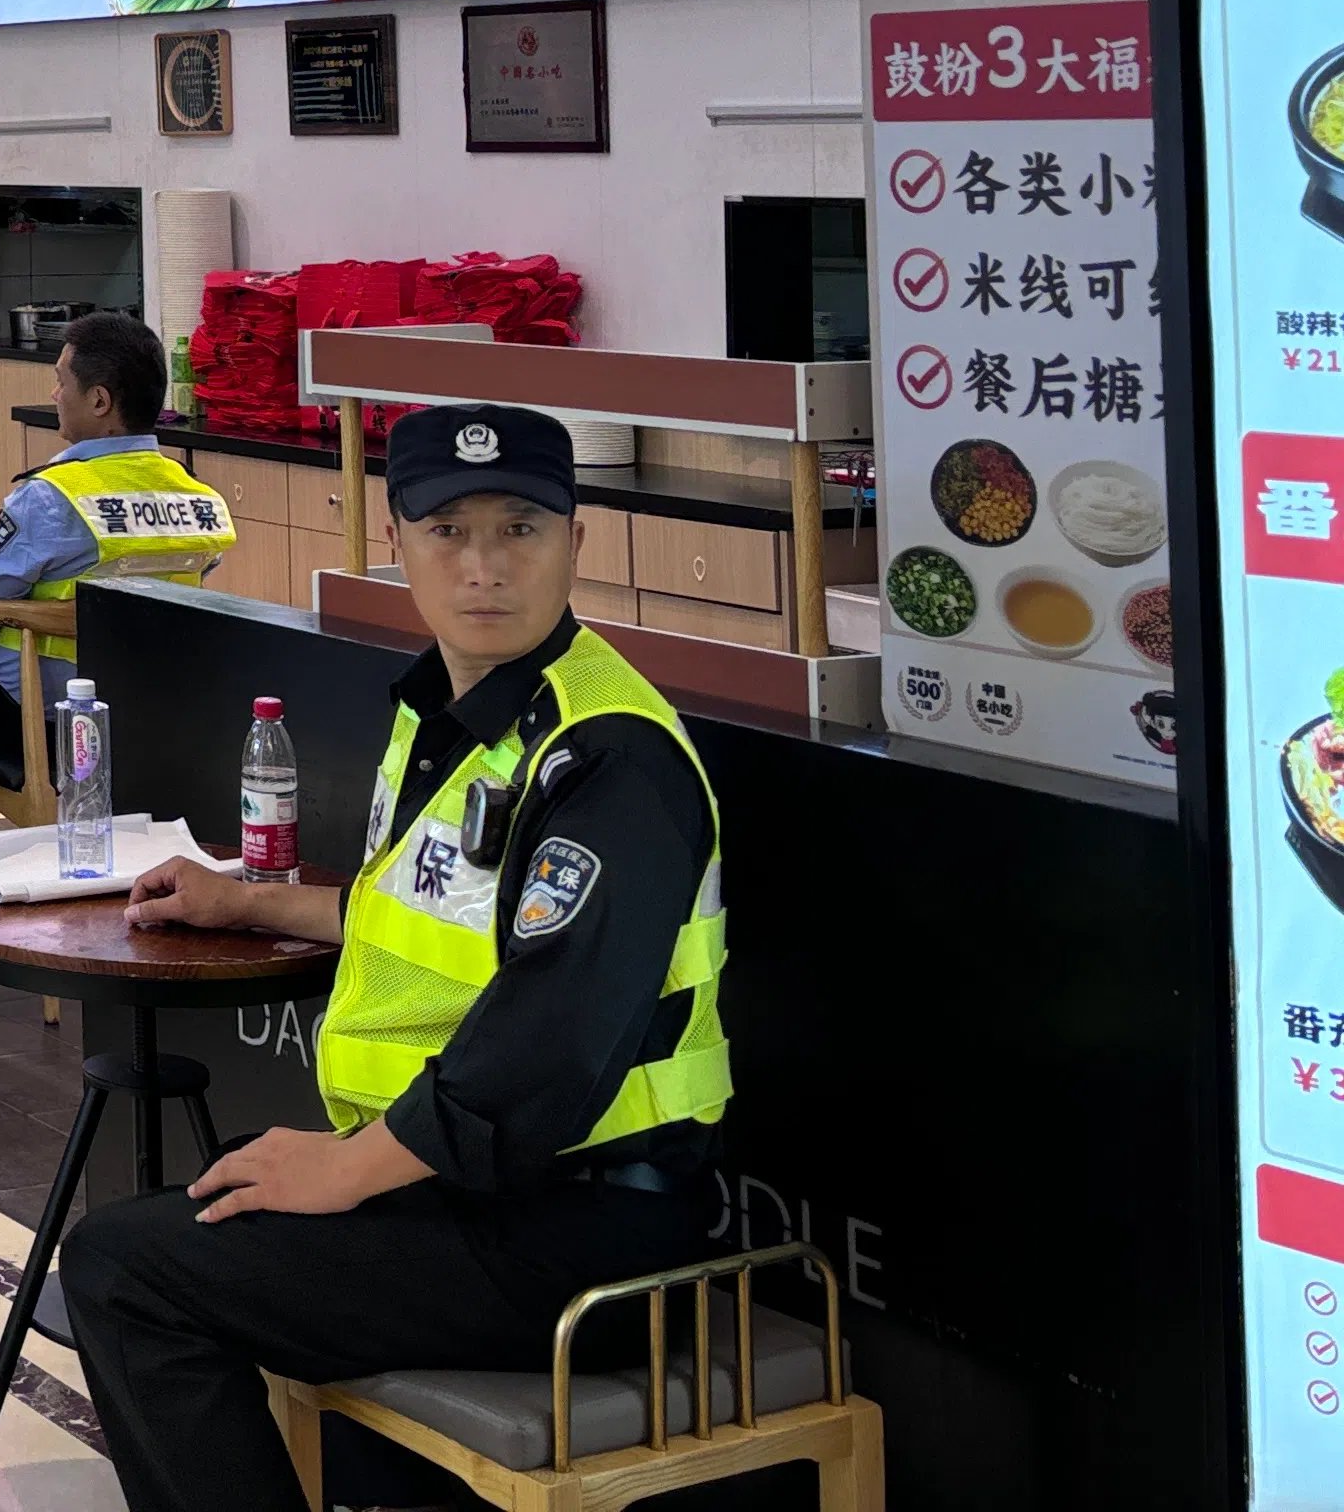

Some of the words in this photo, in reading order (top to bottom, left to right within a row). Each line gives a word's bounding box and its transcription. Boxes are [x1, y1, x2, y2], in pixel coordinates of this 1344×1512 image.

[883, 25, 1152, 98] 鼓粉3大福
[960, 251, 1163, 321] 米线可
[1276, 310, 1344, 337] 酸辣
[95, 498, 129, 534] 警
[133, 498, 189, 527] POLICE
[189, 497, 222, 532] 察
[414, 834, 460, 899] 保
[556, 865, 581, 890] 保
